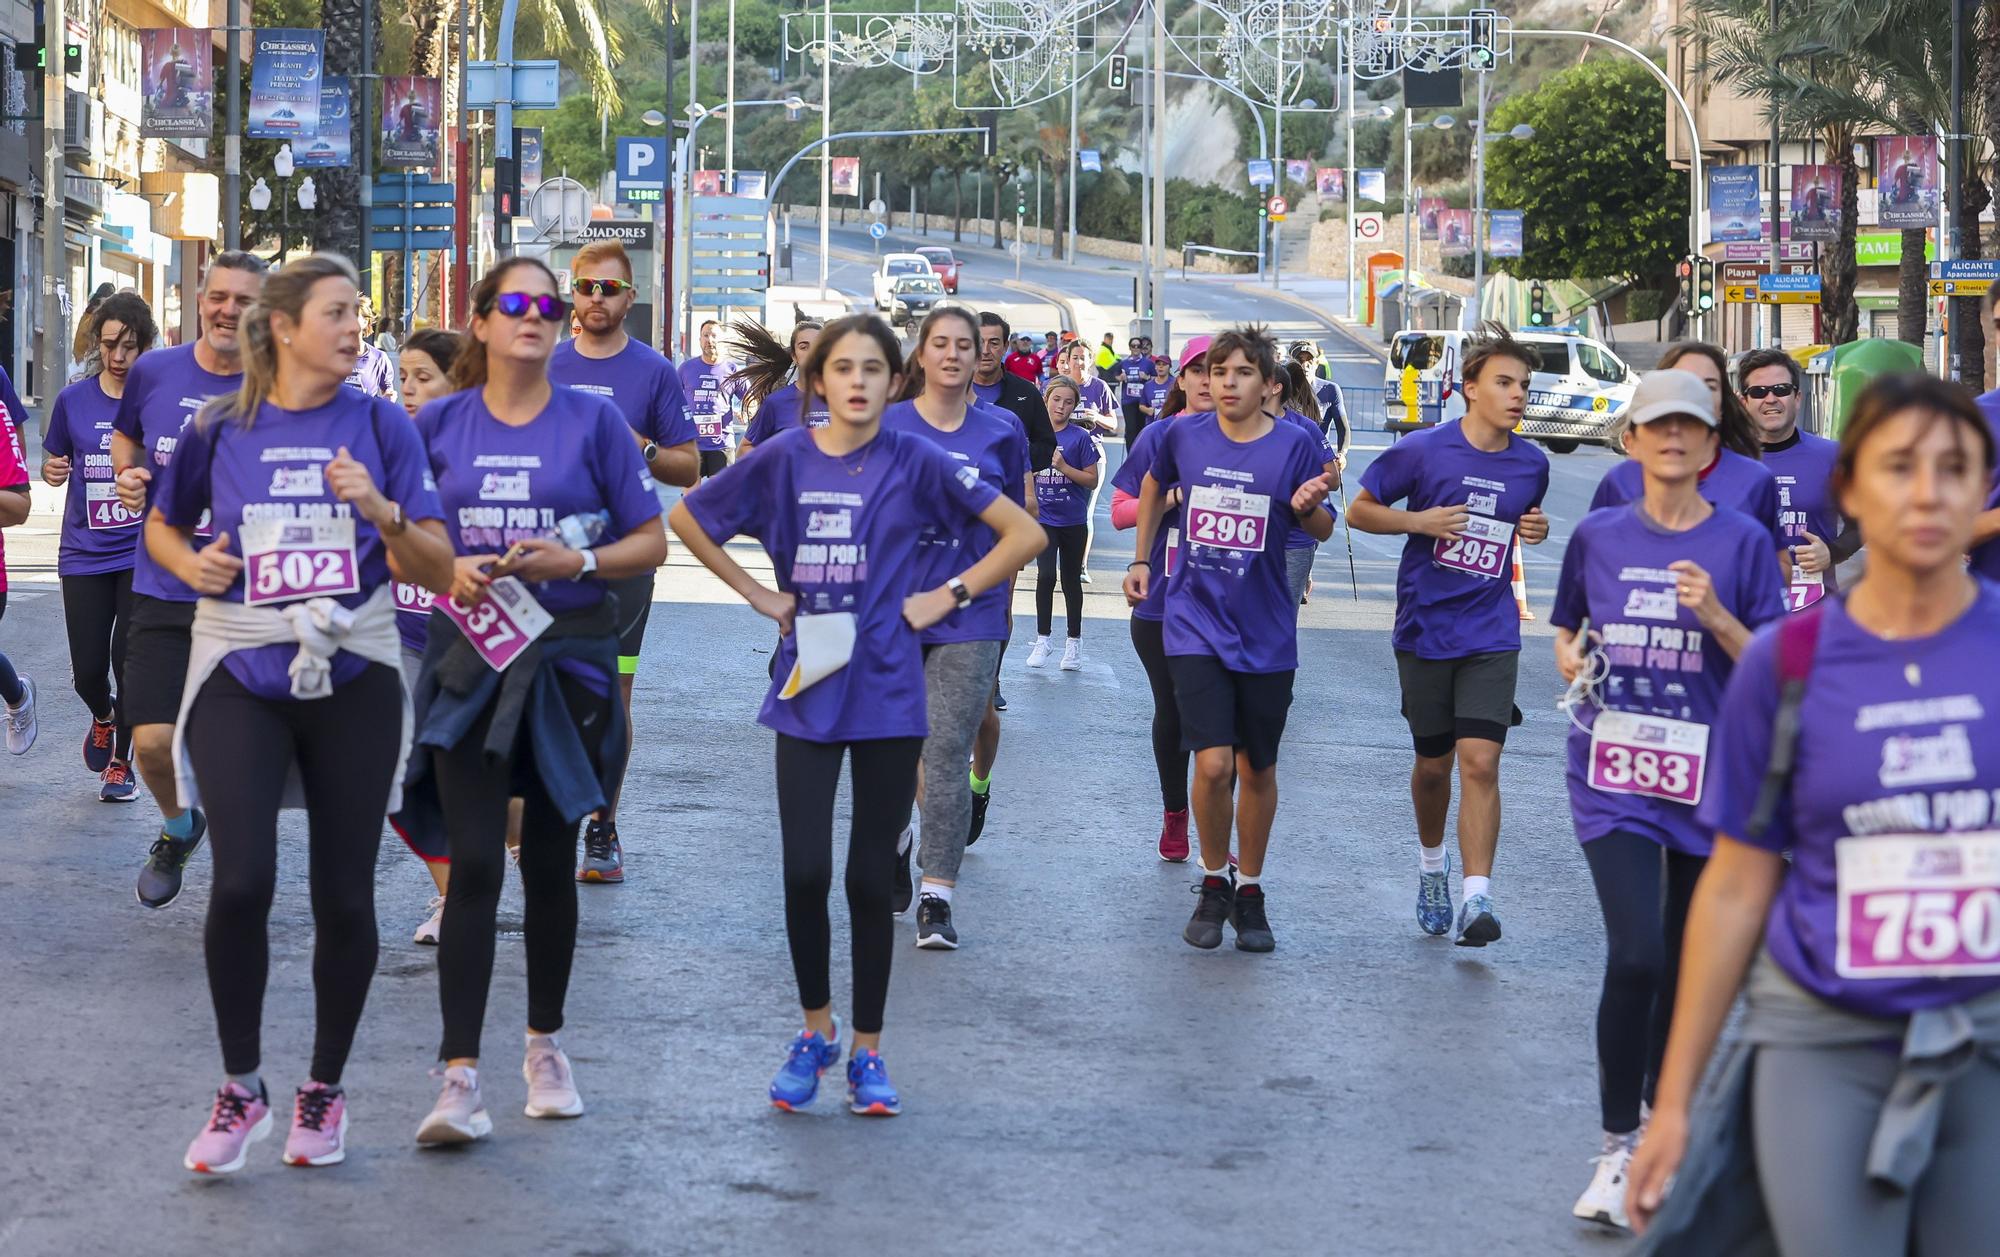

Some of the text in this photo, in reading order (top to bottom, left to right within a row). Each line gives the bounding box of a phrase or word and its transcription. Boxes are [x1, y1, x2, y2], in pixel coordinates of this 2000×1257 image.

[260, 41, 316, 53] CIRCLASSICA
[272, 61, 302, 69] ALICANTE
[146, 117, 205, 128] CIRCLASSICA
[629, 144, 655, 176] P
[628, 190, 660, 200] LIBRE
[1883, 210, 1933, 219] CIRCLASSICA
[1952, 262, 1994, 270] ALICANTE
[1727, 268, 1757, 277] Playas
[1947, 271, 1999, 279] Aparcamientos
[84, 466, 113, 478] CORRO
[1196, 512, 1257, 545] 296
[829, 544, 858, 565] POR
[1441, 538, 1498, 569] 295
[256, 551, 346, 595] 502
[1650, 626, 1684, 650] POR
[1603, 745, 1690, 794] 383
[1864, 888, 2000, 961] 750
